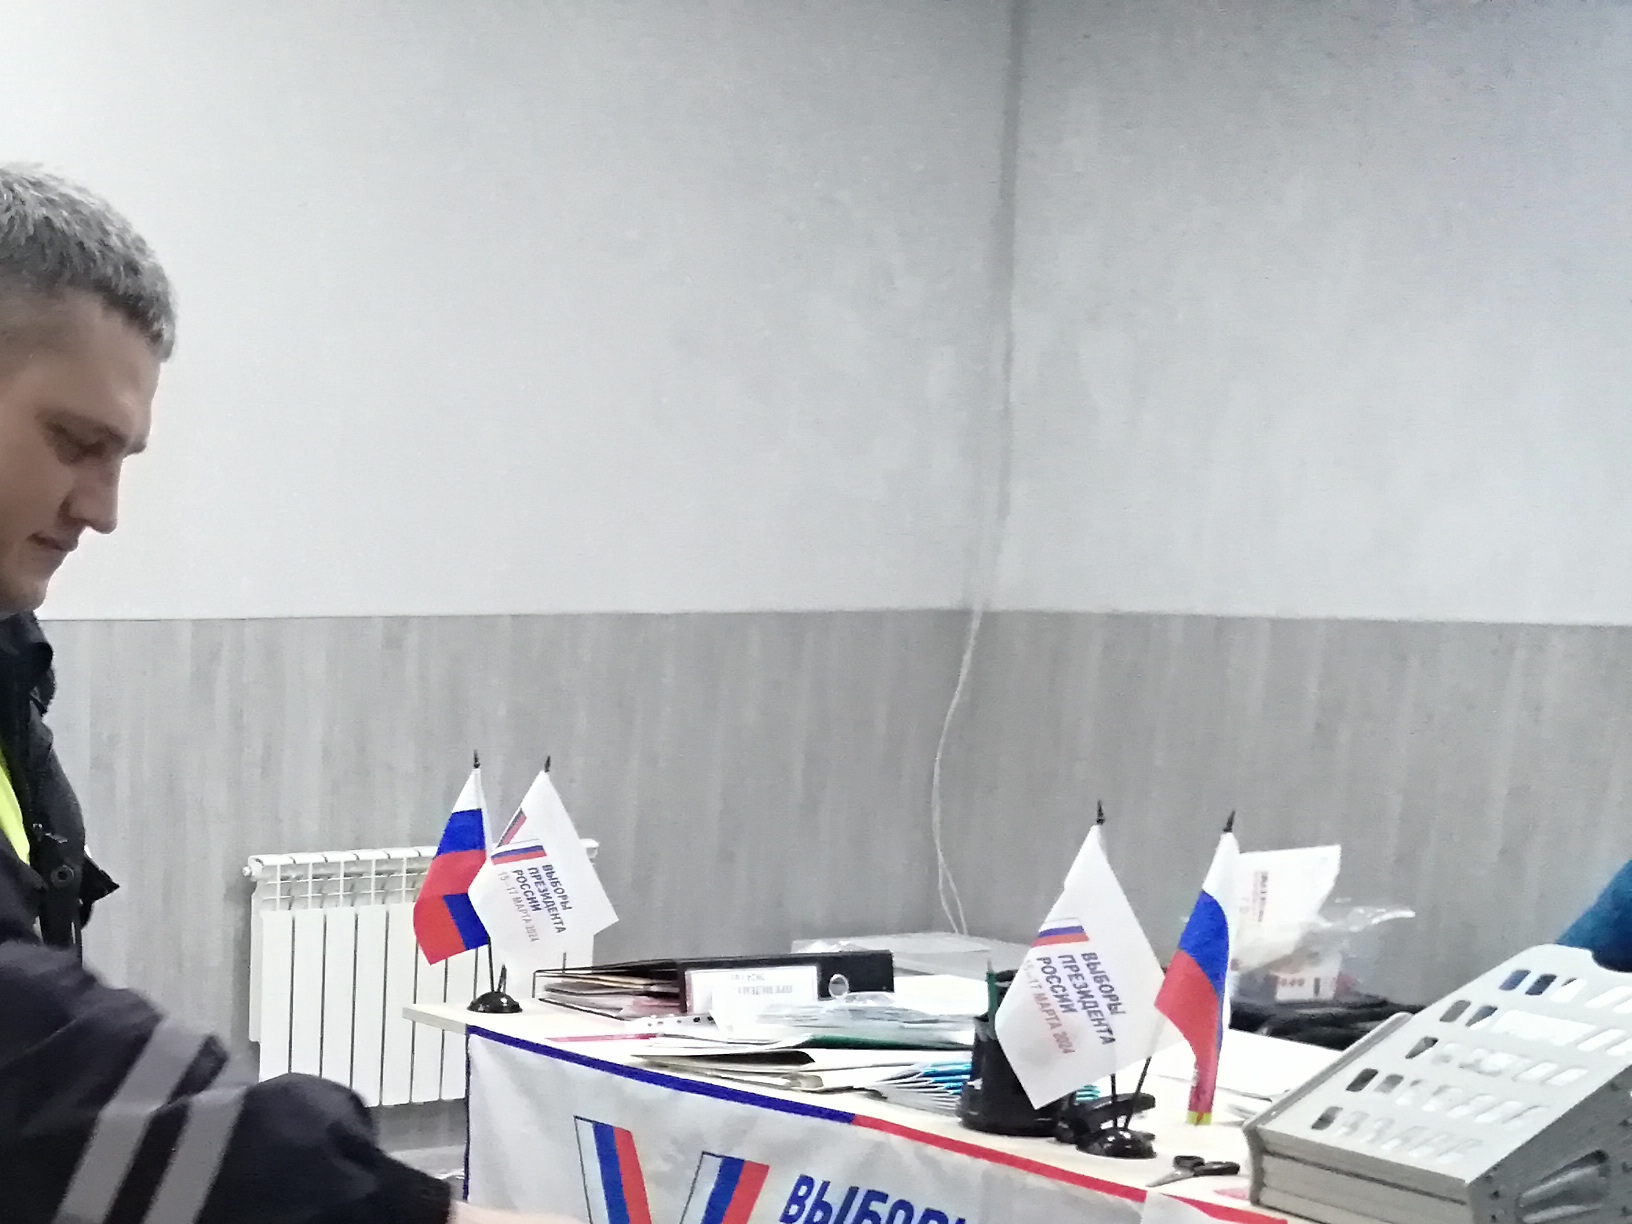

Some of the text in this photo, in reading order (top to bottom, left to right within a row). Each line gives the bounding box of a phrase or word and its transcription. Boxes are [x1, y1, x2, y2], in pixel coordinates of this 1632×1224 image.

[512, 869, 542, 911] РОССИИ
[513, 896, 532, 923] МАРТА
[528, 867, 567, 933] ПРЕЗИДЕНТА
[542, 864, 573, 910] ВЫБОРЫ
[1036, 957, 1078, 1013] РОССИИ
[1057, 954, 1116, 1045] ПРЕЗИДЕНТА
[1081, 952, 1126, 1015] ВЫБОРЫ
[1033, 992, 1062, 1030] МАРТА
[1052, 1031, 1076, 1054] 2024
